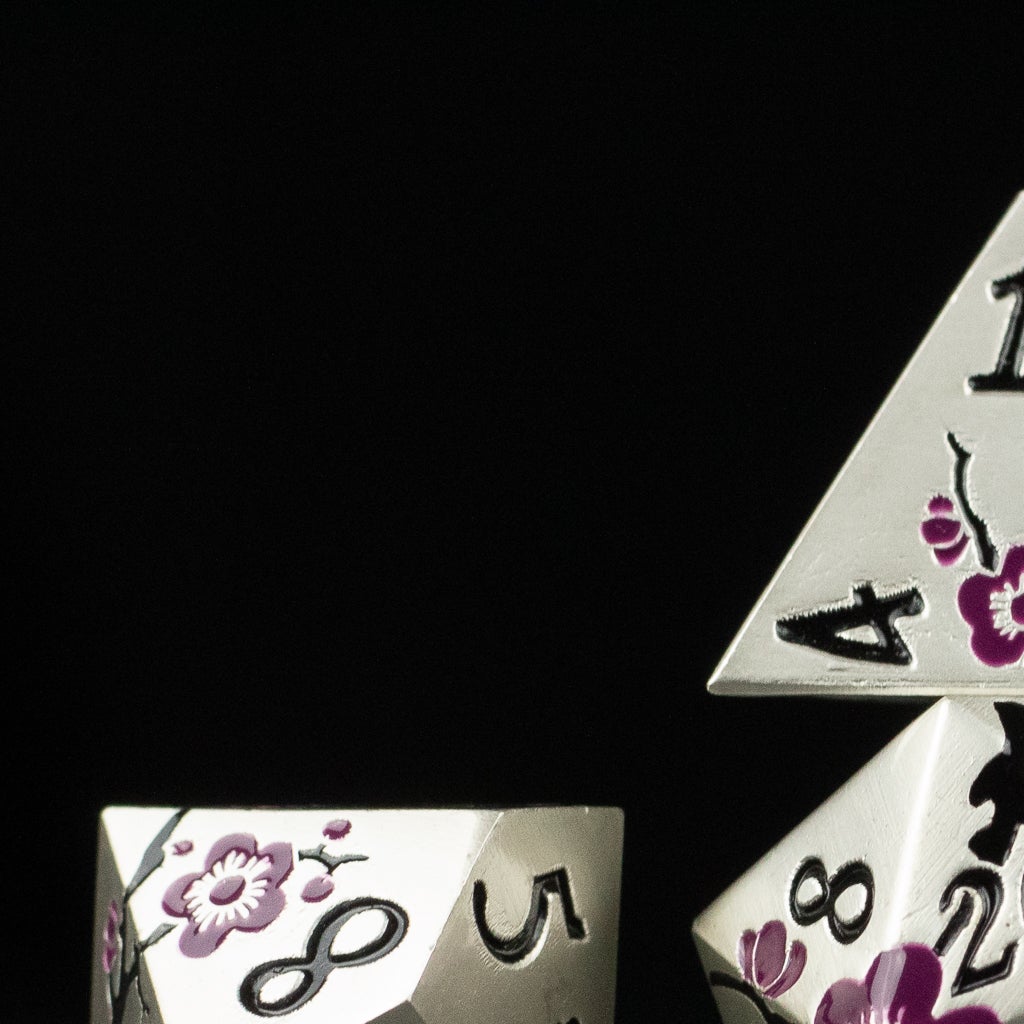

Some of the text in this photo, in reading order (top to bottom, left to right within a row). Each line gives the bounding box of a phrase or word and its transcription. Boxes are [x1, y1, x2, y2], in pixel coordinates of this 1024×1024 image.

[775, 580, 925, 670] 4
[471, 866, 588, 966] 5
[787, 855, 876, 946] 8
[238, 896, 411, 1018] 8
